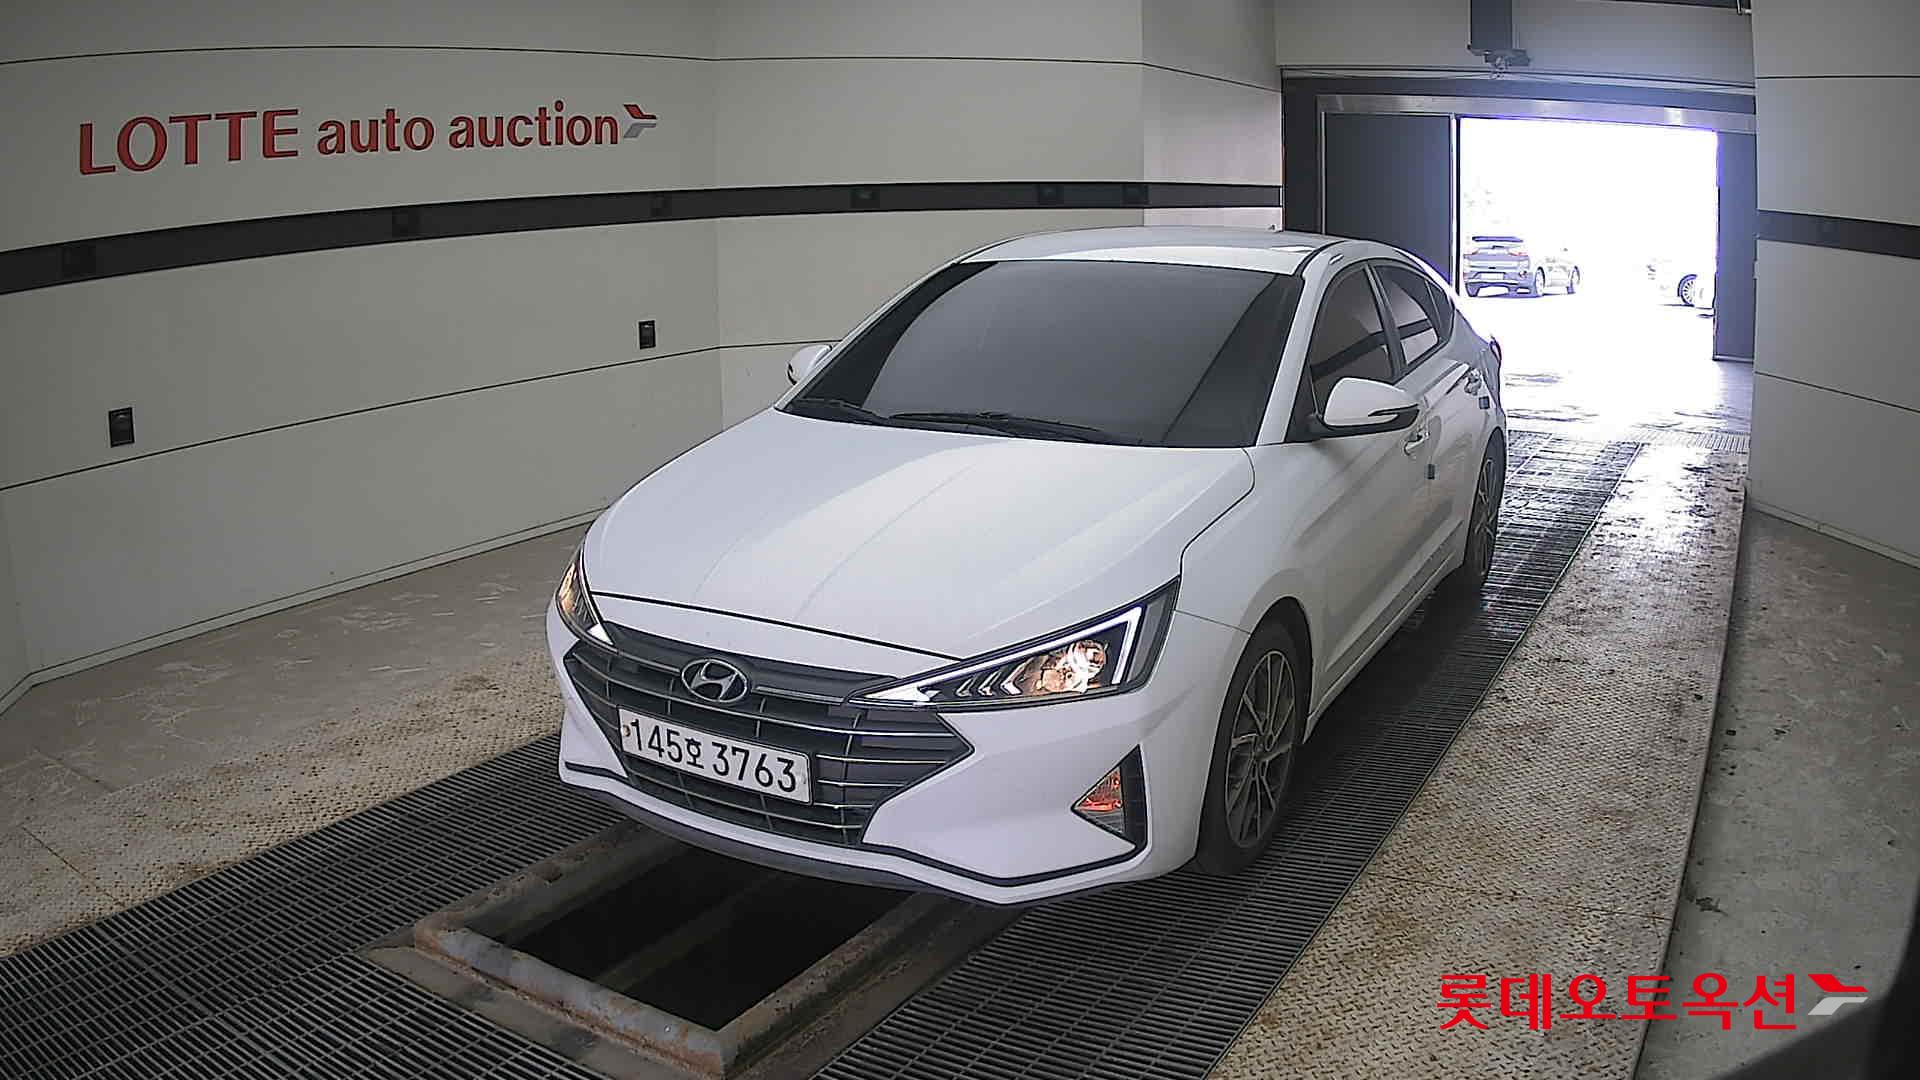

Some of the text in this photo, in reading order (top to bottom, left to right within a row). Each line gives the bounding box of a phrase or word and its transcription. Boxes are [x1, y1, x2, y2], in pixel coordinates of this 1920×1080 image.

[79, 100, 618, 175] LOTTE auto auction
[630, 718, 796, 792] 145호 3763
